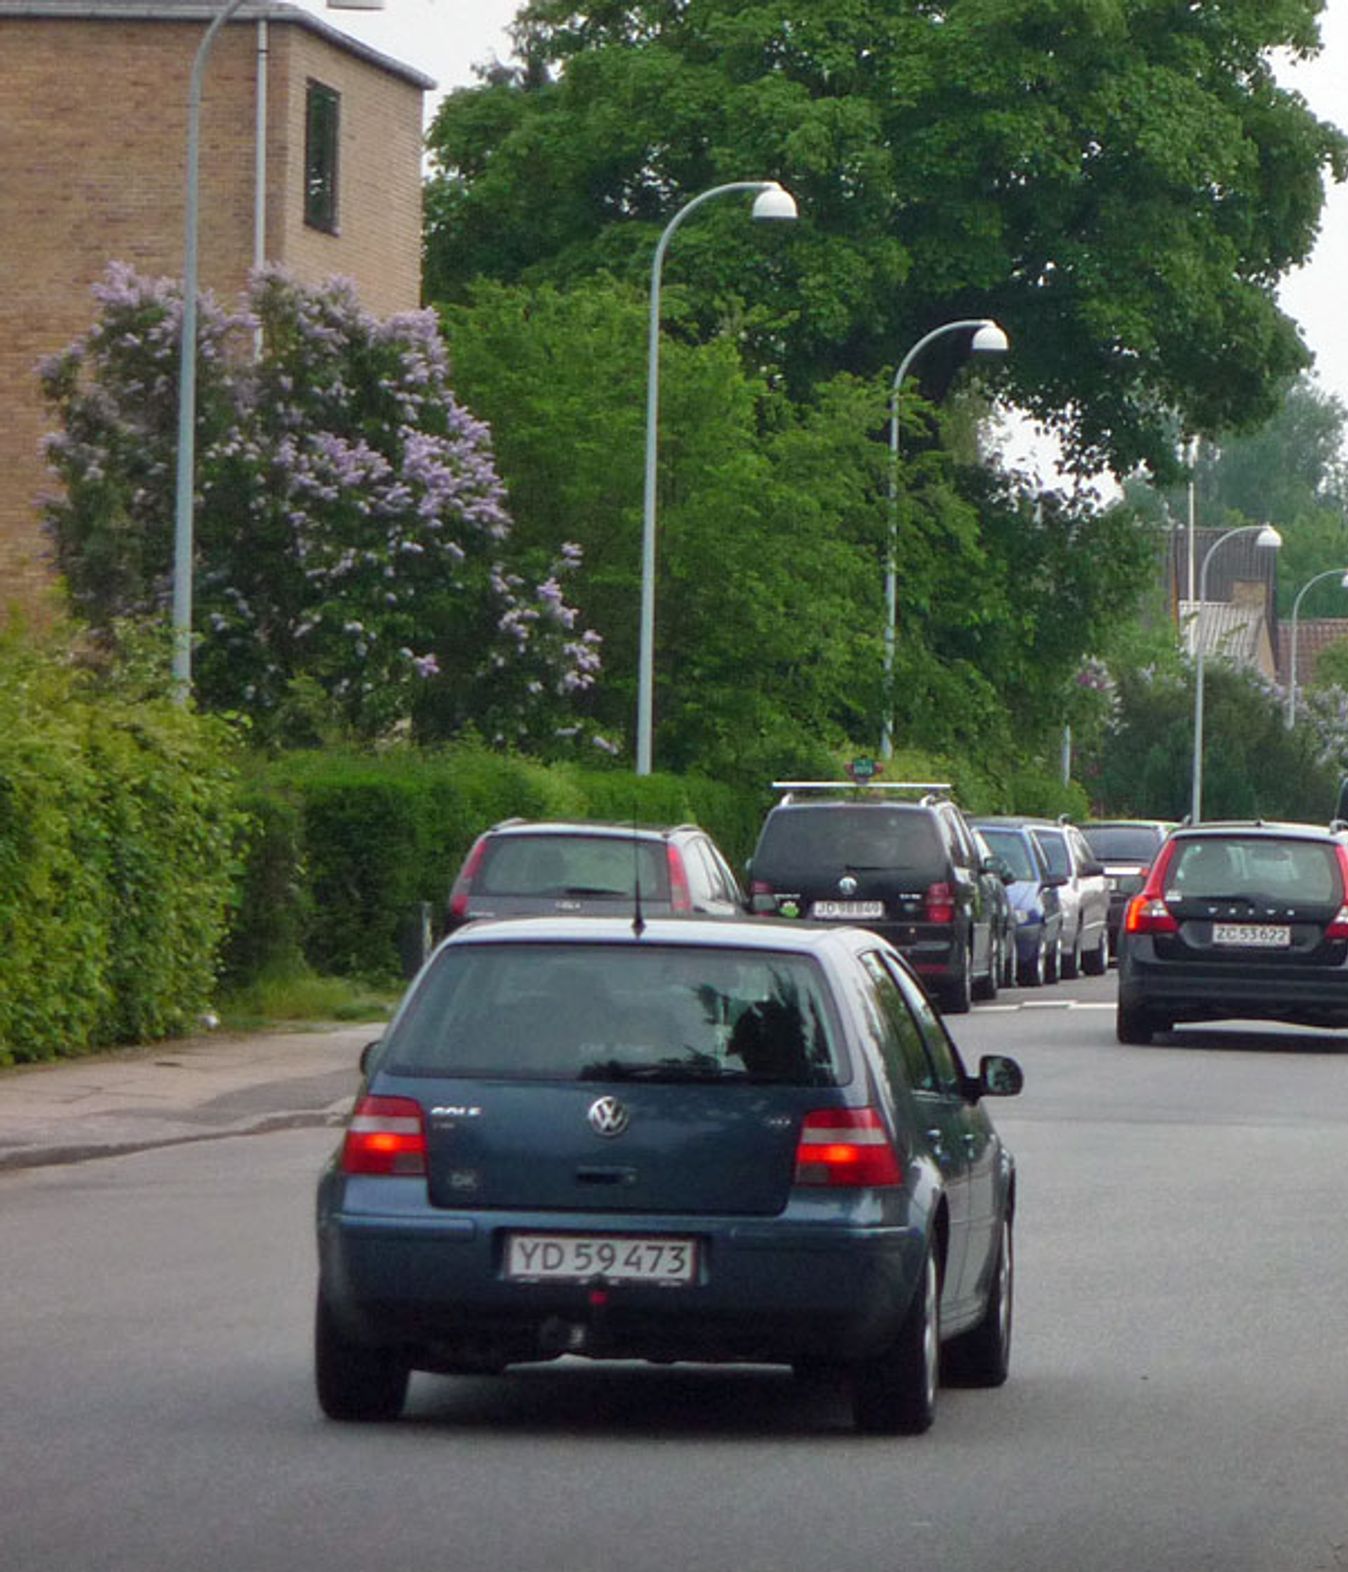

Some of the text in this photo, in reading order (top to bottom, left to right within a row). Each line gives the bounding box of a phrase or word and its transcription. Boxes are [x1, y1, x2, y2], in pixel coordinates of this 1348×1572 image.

[1259, 929, 1287, 941] 622
[518, 1241, 687, 1275] YD 59 473
